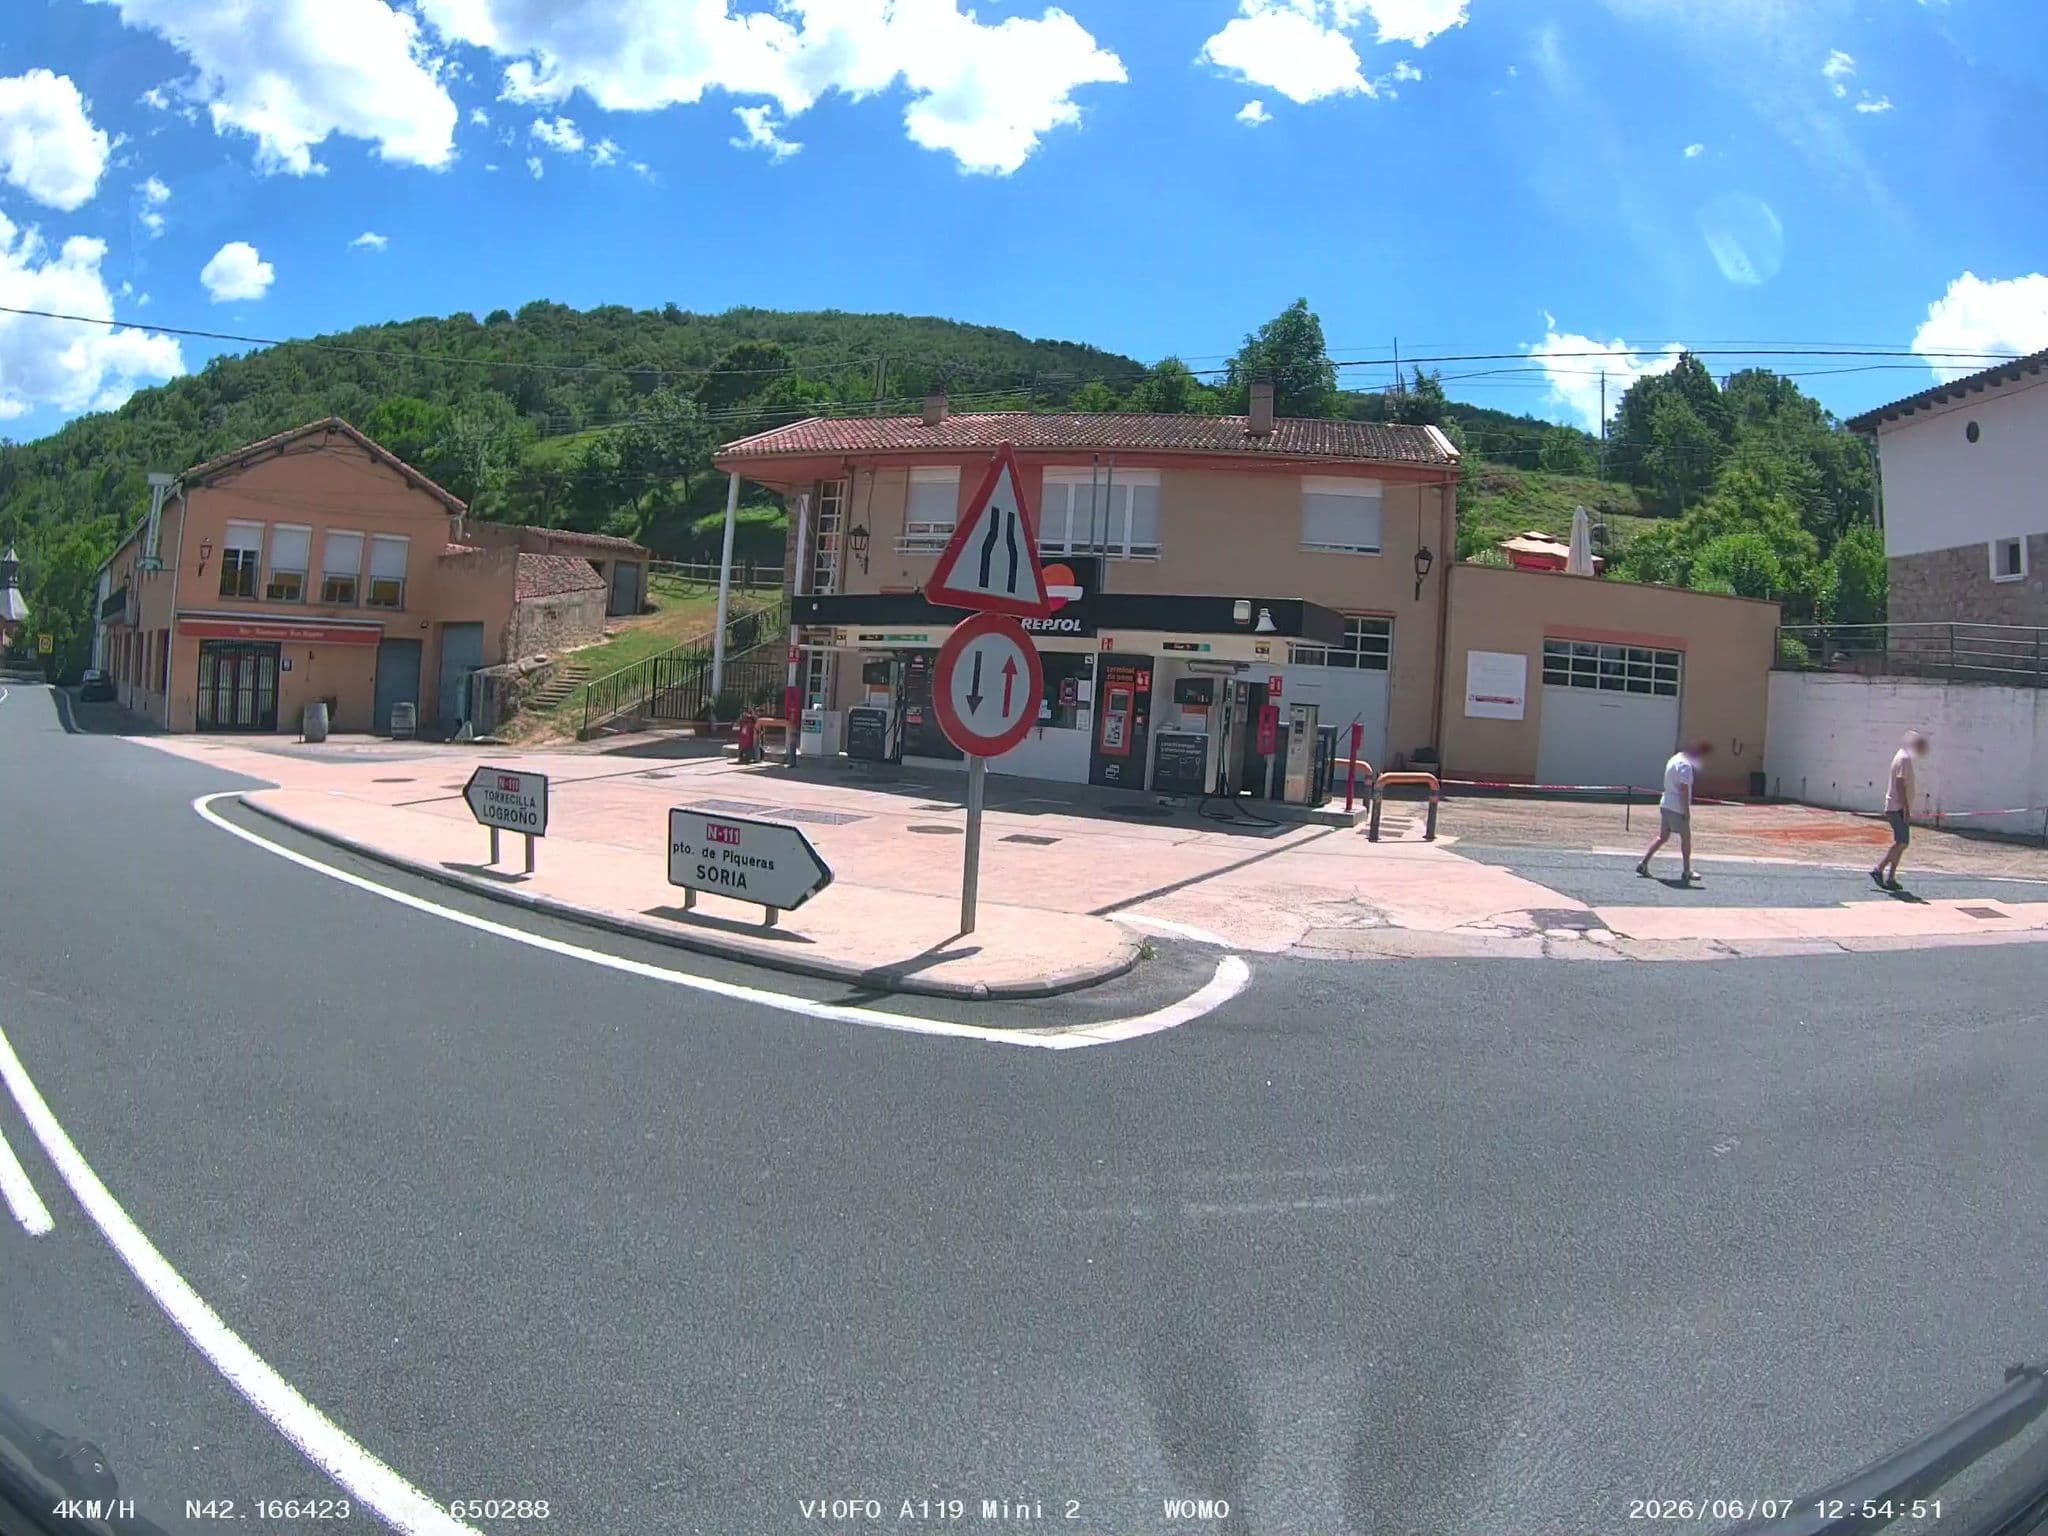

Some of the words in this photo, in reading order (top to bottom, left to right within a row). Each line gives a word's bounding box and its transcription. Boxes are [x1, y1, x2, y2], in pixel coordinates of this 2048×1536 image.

[1021, 618, 1081, 631] REPSOL
[498, 776, 519, 792] N-111
[484, 790, 536, 808] TORRECILLA
[706, 825, 740, 843] N-111
[672, 841, 694, 855] pto.
[702, 847, 716, 859] de
[722, 849, 776, 871] Piqueras
[696, 864, 747, 891] SORIA
